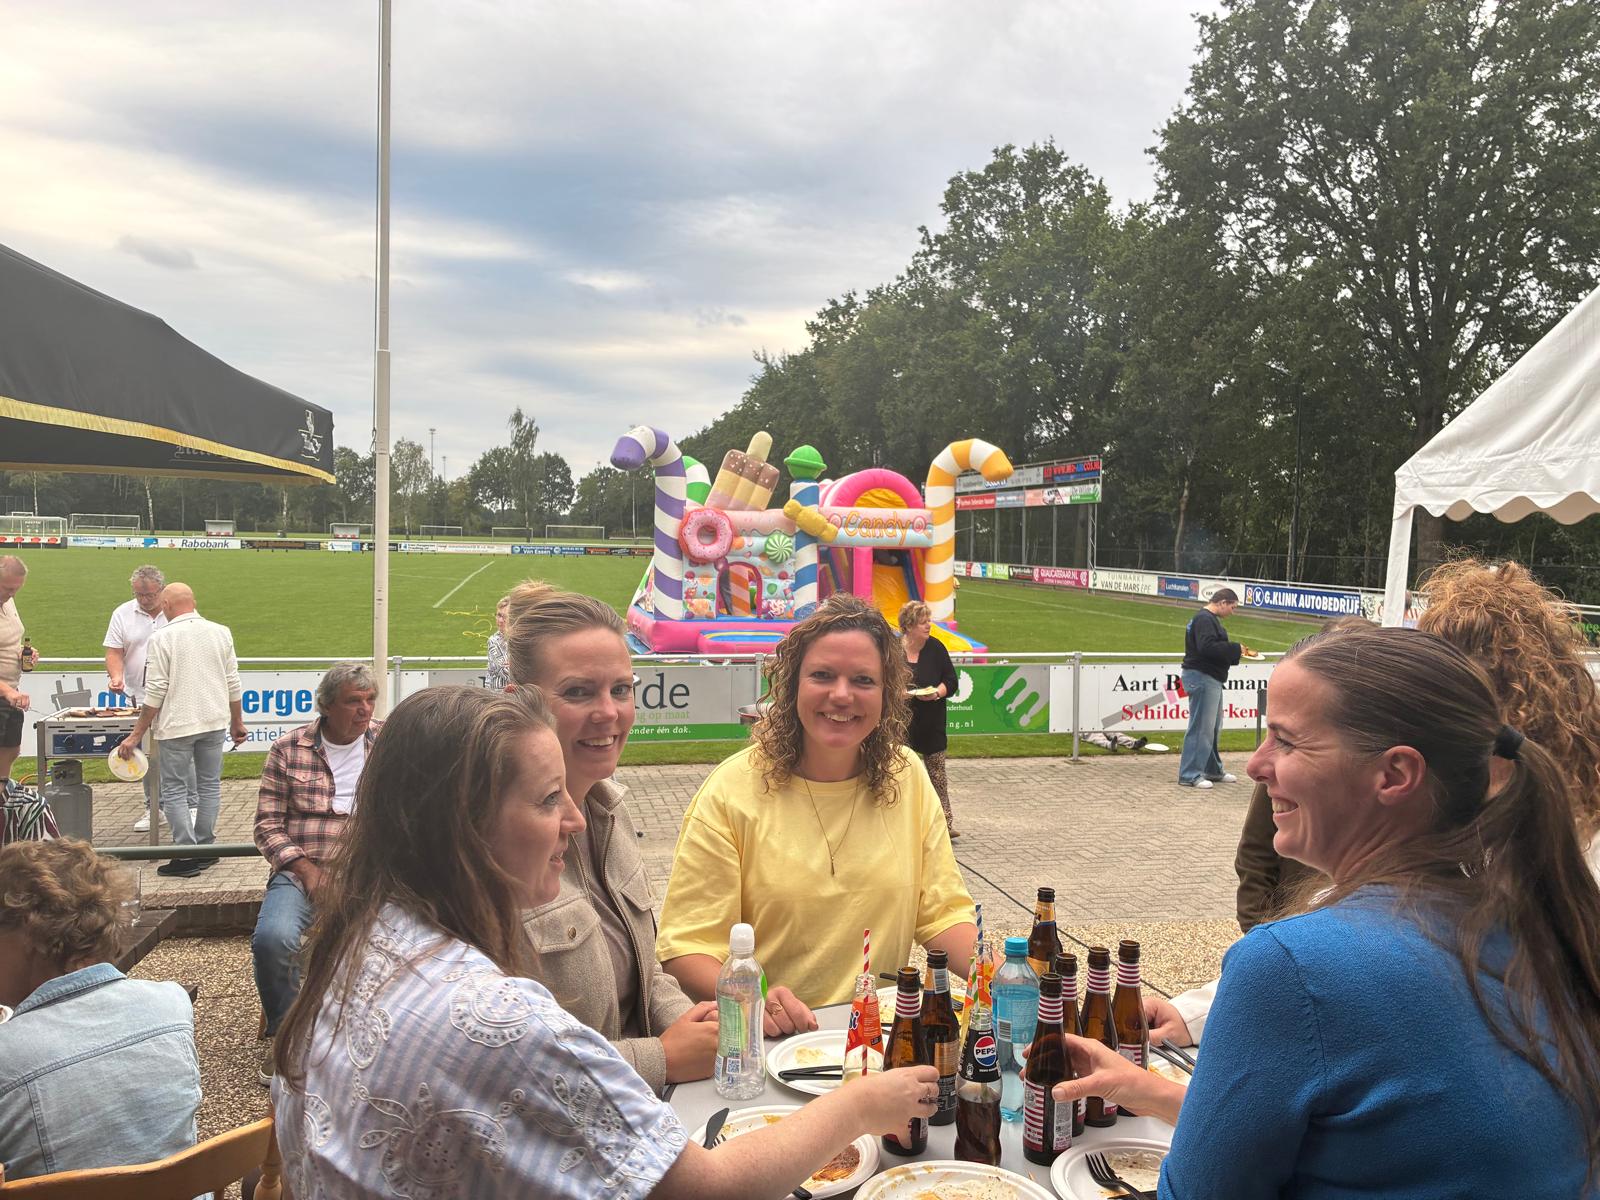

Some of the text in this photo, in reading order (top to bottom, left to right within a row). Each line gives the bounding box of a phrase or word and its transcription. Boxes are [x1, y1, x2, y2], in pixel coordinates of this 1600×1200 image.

[844, 511, 911, 546] Candy
[181, 539, 230, 550] Rabobank
[1108, 573, 1145, 582] TUINMARKT
[1101, 581, 1114, 590] VAN
[1114, 582, 1123, 591] DE
[1122, 583, 1140, 592] MARS
[1264, 591, 1298, 608] G.KLINK
[1298, 594, 1361, 616] AUTOBEDRIJF
[1112, 674, 1159, 692] Aart
